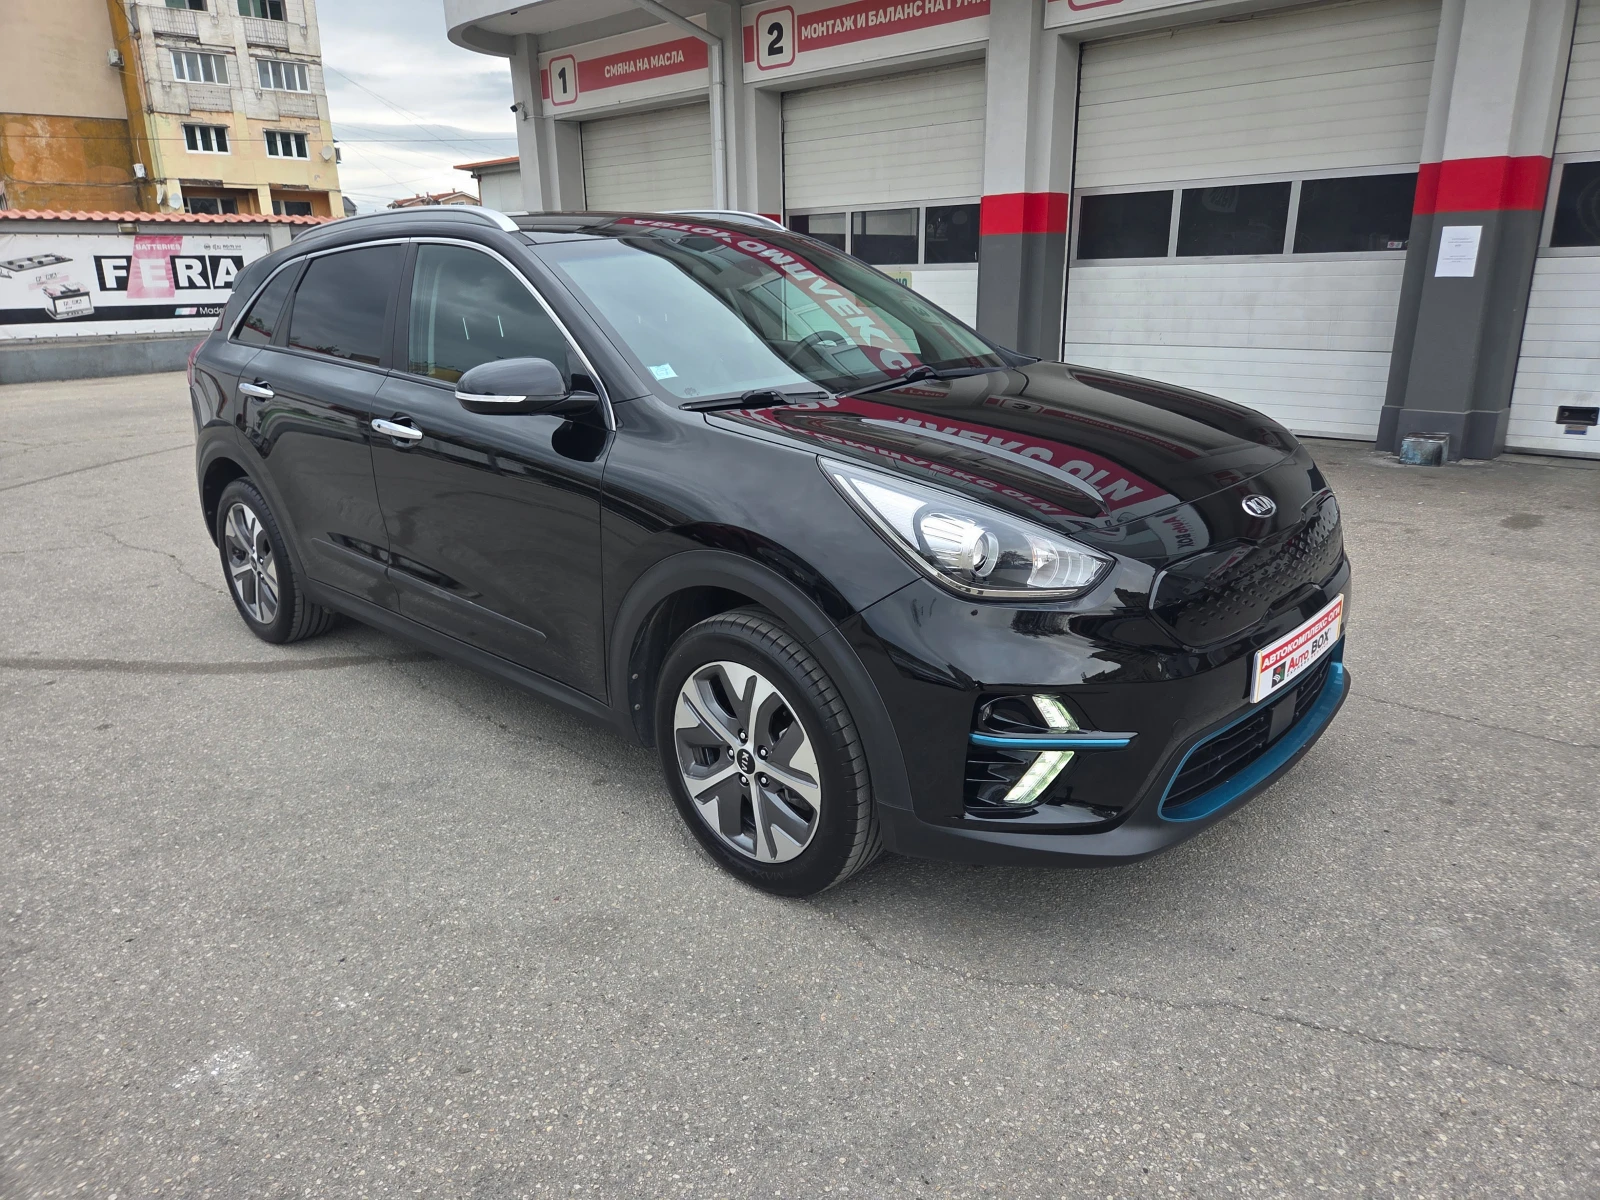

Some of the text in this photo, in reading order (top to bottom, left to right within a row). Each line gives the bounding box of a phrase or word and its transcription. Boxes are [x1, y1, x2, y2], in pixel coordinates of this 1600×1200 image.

[801, 15, 855, 40] МОНТАЖ
[857, 13, 865, 28] И
[868, 1, 923, 26] БАЛАНС
[767, 22, 783, 56] 2
[604, 50, 685, 78] СМЯНА НА МАСЛА
[558, 67, 567, 94] 1
[135, 243, 181, 251] BATTERIES
[101, 256, 240, 289] FERA
[1262, 616, 1328, 669] АВТОКОМПЛЕКС
[1311, 629, 1329, 654] BOX
[741, 751, 749, 771] KIA
